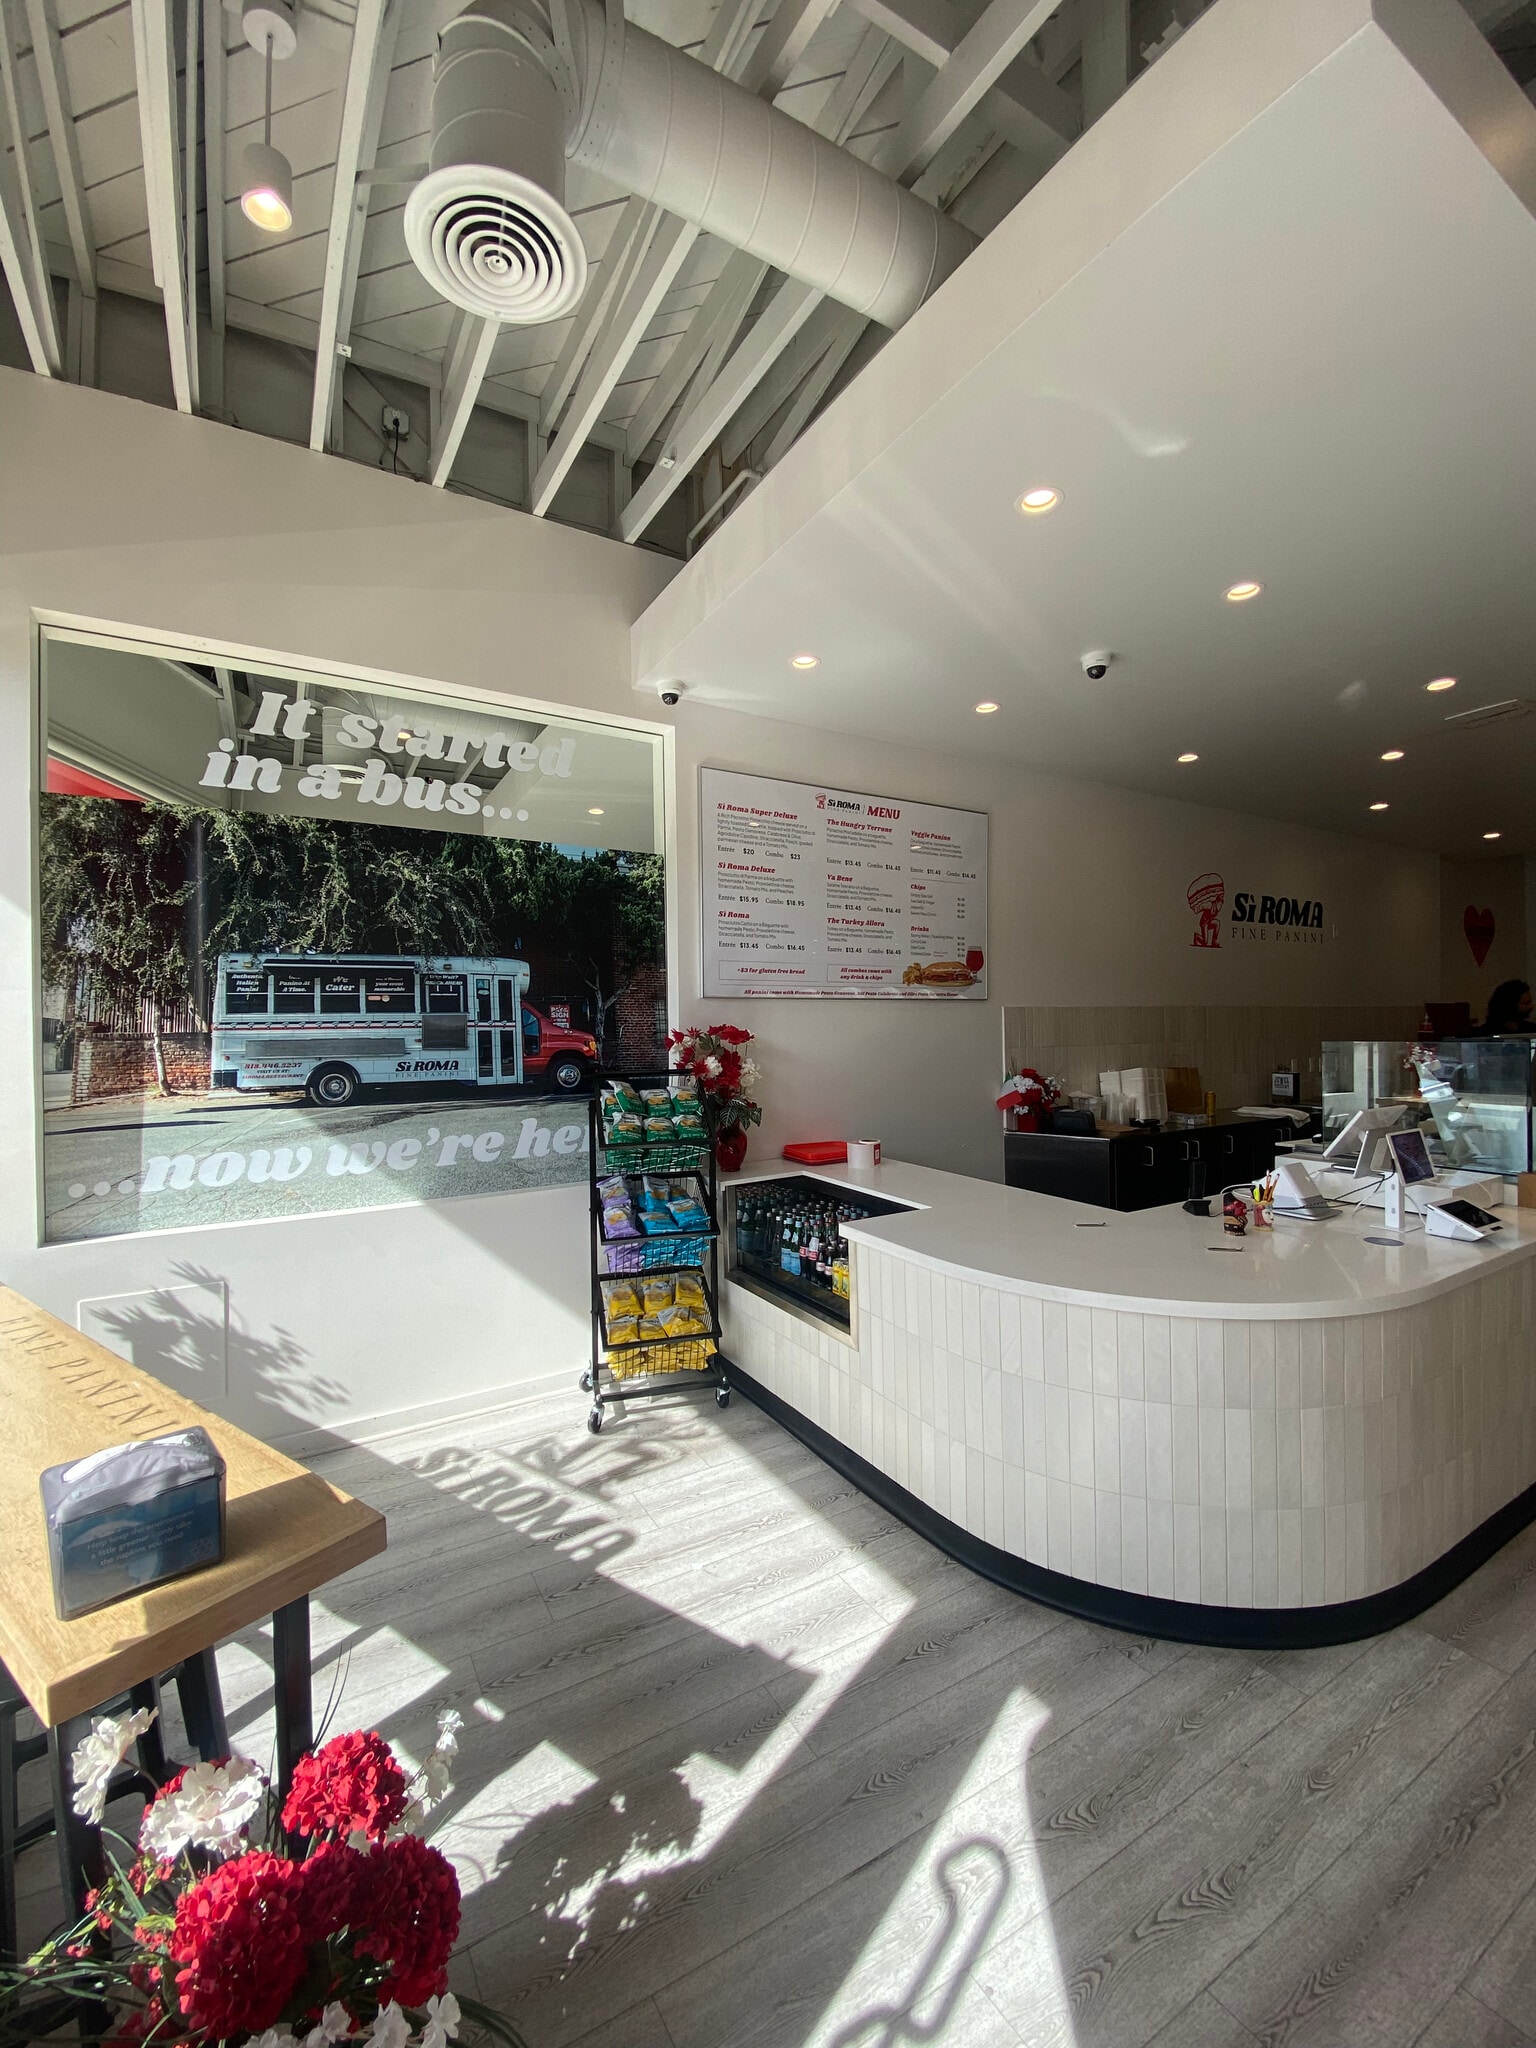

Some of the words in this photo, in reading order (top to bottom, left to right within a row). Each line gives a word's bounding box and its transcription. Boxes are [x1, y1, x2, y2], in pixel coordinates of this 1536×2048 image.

[250, 691, 316, 741] It
[336, 714, 576, 779] started
[199, 738, 282, 795] in
[298, 764, 342, 800] a
[357, 757, 528, 822] bus...
[726, 803, 748, 813] Roma
[749, 806, 773, 817] Super
[773, 810, 797, 820] Deluxe
[836, 800, 860, 810] ROMA
[866, 805, 900, 820] MENU
[826, 818, 839, 826] The
[840, 819, 865, 830] Hungry
[866, 823, 892, 834] Terrone
[911, 829, 929, 839] Veggie
[930, 832, 950, 842] Panino
[717, 844, 735, 853] Entrée
[743, 847, 754, 855] $20
[764, 850, 783, 858] Combo
[726, 862, 749, 871] Roma
[750, 865, 775, 873] Deluxe
[866, 861, 883, 869] Combo
[836, 874, 852, 882] Bene
[910, 883, 925, 891] Chips
[718, 893, 735, 901] Entrée
[739, 895, 758, 903] $15.95
[765, 897, 784, 905] Combo
[1232, 893, 1257, 922] Sì
[1258, 895, 1324, 929] ROMA
[827, 916, 839, 924] The
[840, 917, 864, 926] Turkey
[865, 919, 884, 927] Allora
[1232, 928, 1267, 940] FINE
[1276, 930, 1323, 944] PANINI
[739, 941, 758, 949] $13.45
[413, 1060, 459, 1072] ROMA
[68, 1145, 313, 1198] ...now
[324, 1128, 505, 1178] we're
[47, 1357, 180, 1437] PANINI
[87, 1540, 107, 1550] Help
[100, 1557, 114, 1566] the
[116, 1545, 146, 1561] napkins
[148, 1541, 163, 1551] you
